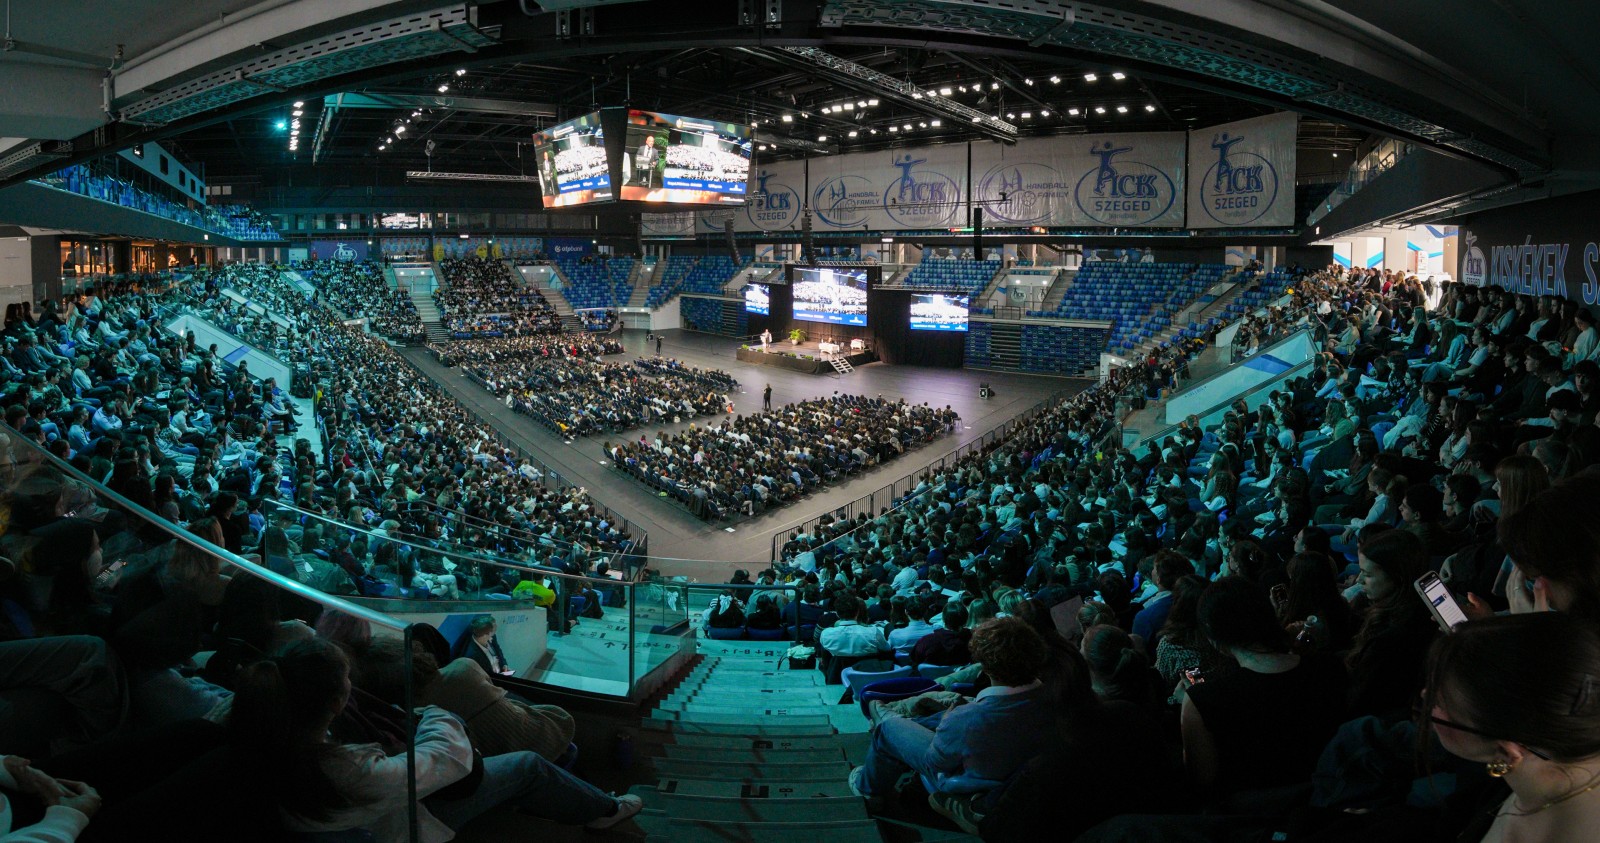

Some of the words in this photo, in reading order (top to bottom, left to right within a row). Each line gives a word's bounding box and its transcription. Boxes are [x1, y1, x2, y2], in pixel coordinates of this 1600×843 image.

[1095, 200, 1151, 212] SZEGED
[1215, 196, 1258, 209] SZEGED
[757, 211, 787, 221] SZEGED
[900, 206, 941, 216] SZEGED
[1490, 234, 1569, 300] KISKÉKEK
[1582, 242, 1600, 305] S
